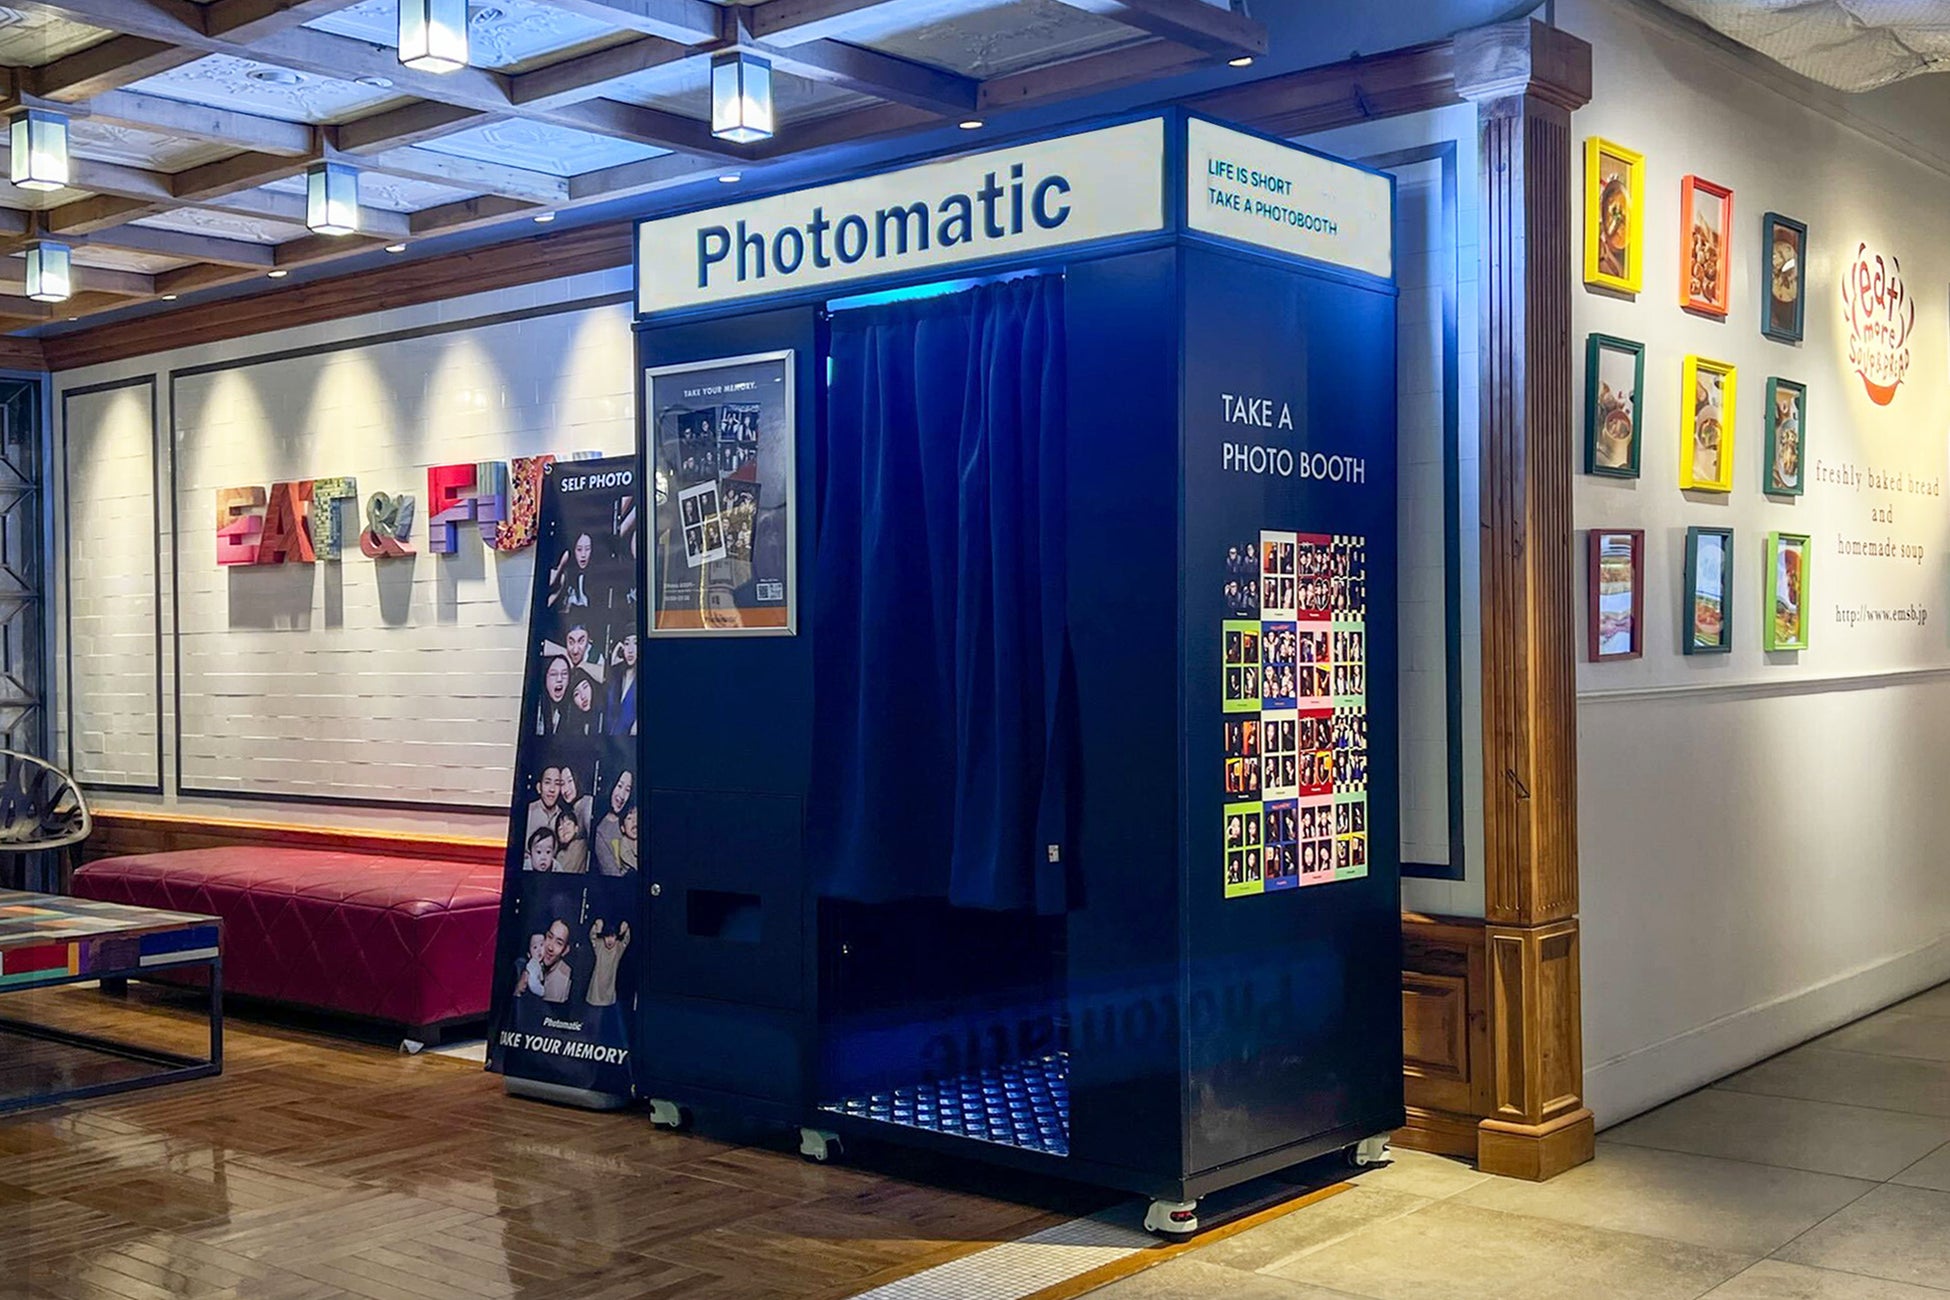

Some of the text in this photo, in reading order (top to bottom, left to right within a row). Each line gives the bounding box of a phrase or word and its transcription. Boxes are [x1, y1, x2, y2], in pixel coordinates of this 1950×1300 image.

[1208, 159, 1292, 196] LIFE IS SHORT
[697, 162, 1072, 289] Photomatic
[1208, 187, 1338, 236] TAKE A PHOTOBOOTH
[1859, 254, 1899, 322] eat
[1864, 321, 1895, 349] more
[684, 388, 700, 398] TAKE
[702, 386, 722, 396] YOUR
[1222, 394, 1293, 430] TAKE A
[1223, 442, 1365, 484] PHOTO BOOTH
[1816, 459, 1939, 497] freshly baked bread
[561, 471, 632, 492] SELF PHOTO
[216, 451, 603, 566] EAT & FU
[1872, 504, 1893, 524] and
[1838, 533, 1924, 565] homemade soup
[1835, 604, 1928, 628] http://www.emsb.jp
[525, 1034, 560, 1055] YOUR
[562, 1041, 628, 1065] MEMORY
